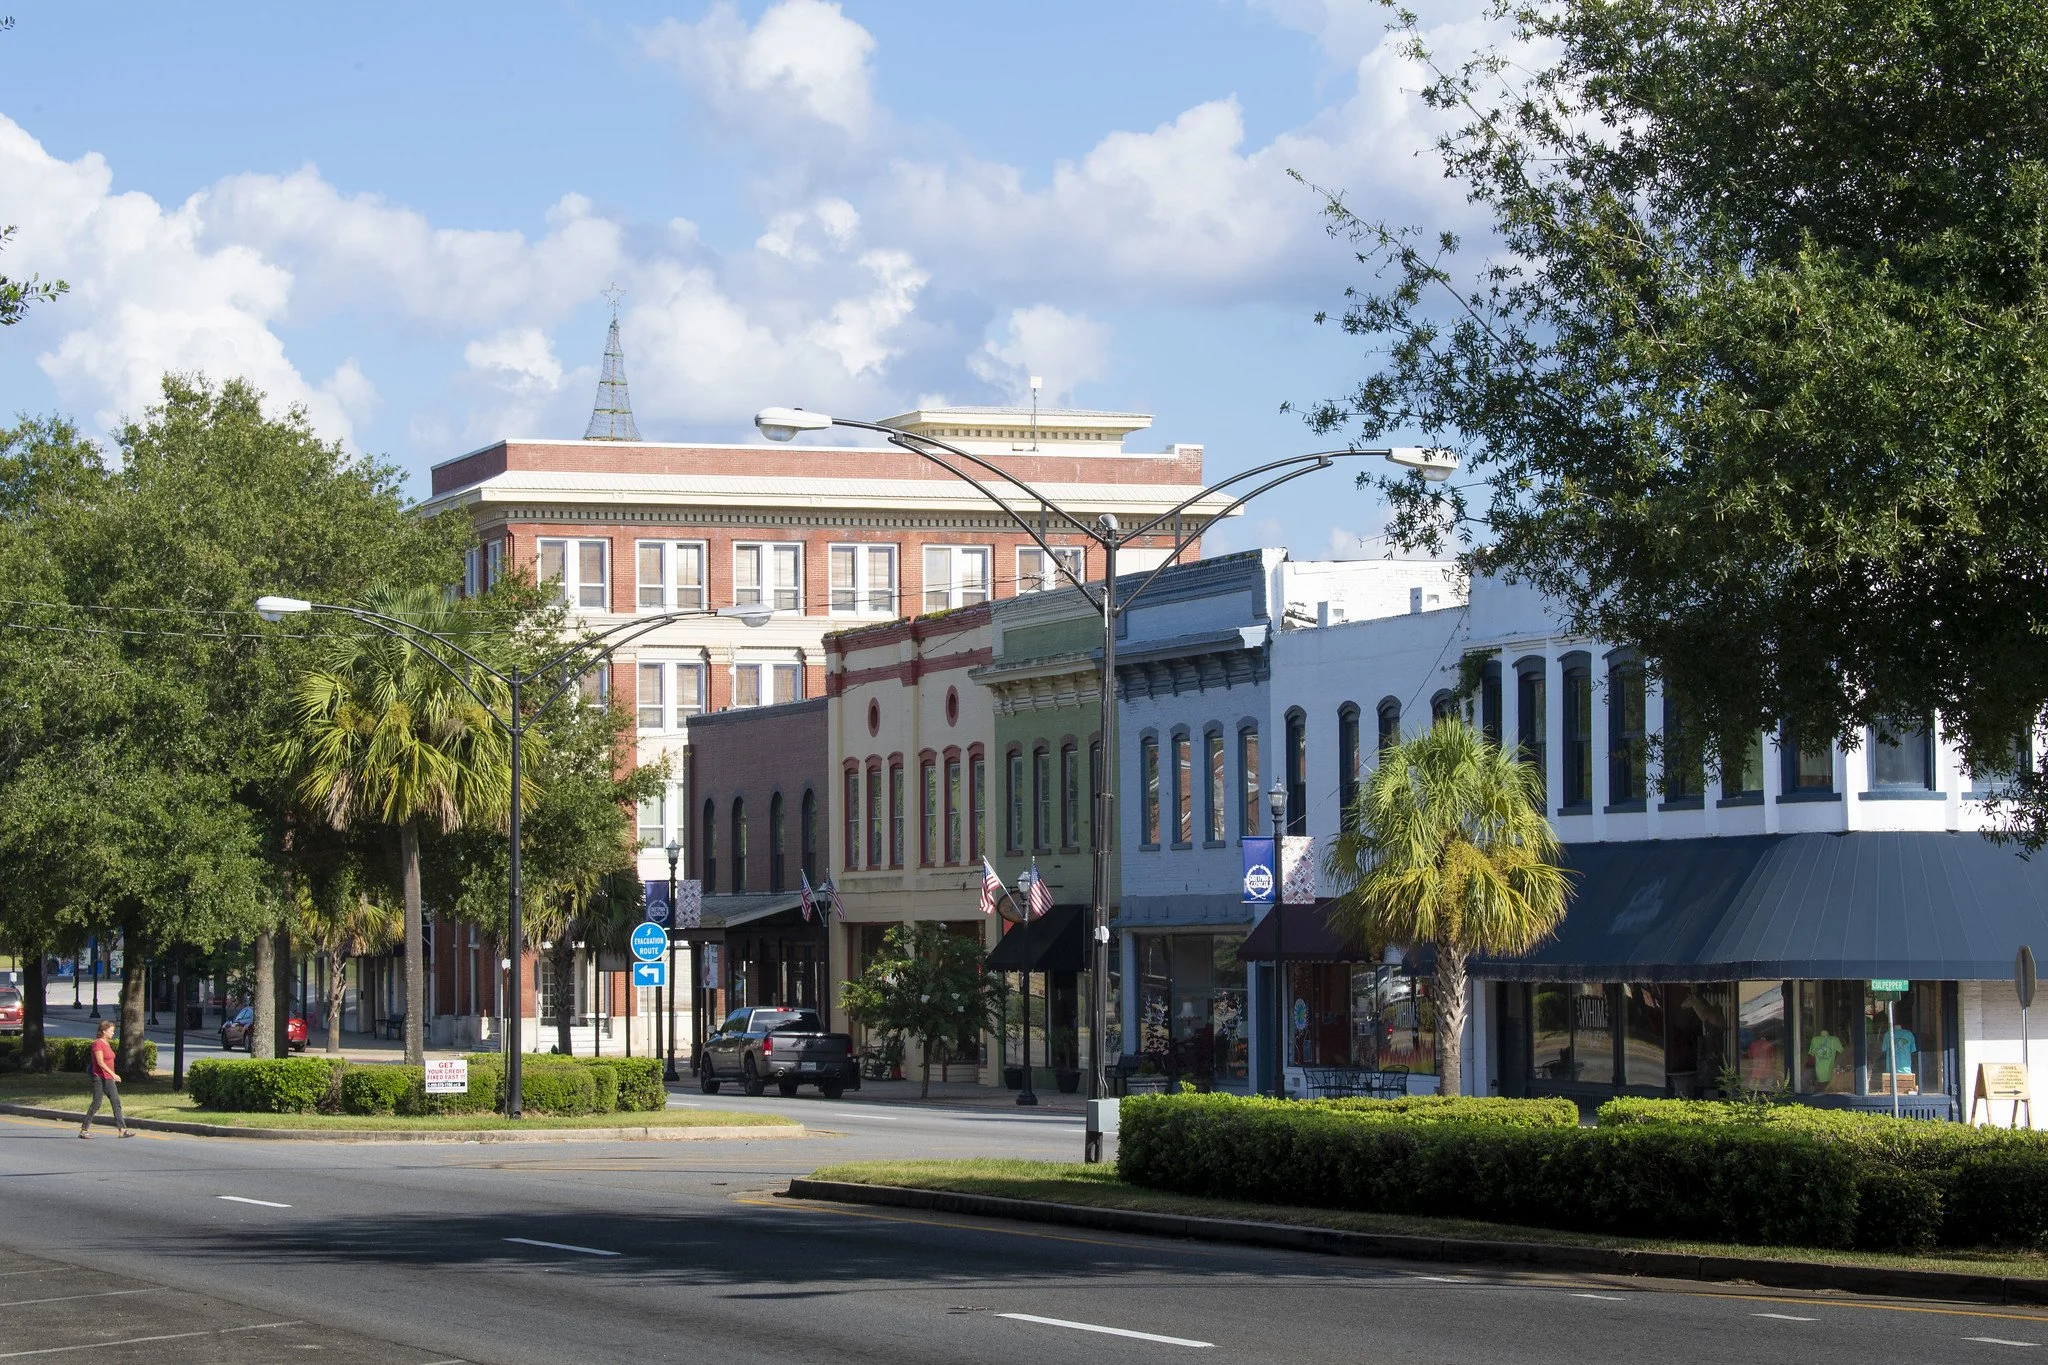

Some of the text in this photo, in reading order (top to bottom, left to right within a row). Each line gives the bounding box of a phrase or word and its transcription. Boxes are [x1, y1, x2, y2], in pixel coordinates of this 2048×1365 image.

[634, 937, 664, 945] EVACUATION
[639, 947, 659, 955] ROUTE
[1872, 980, 1902, 990] CULPEPPER
[1580, 998, 1605, 1028] WHIM
